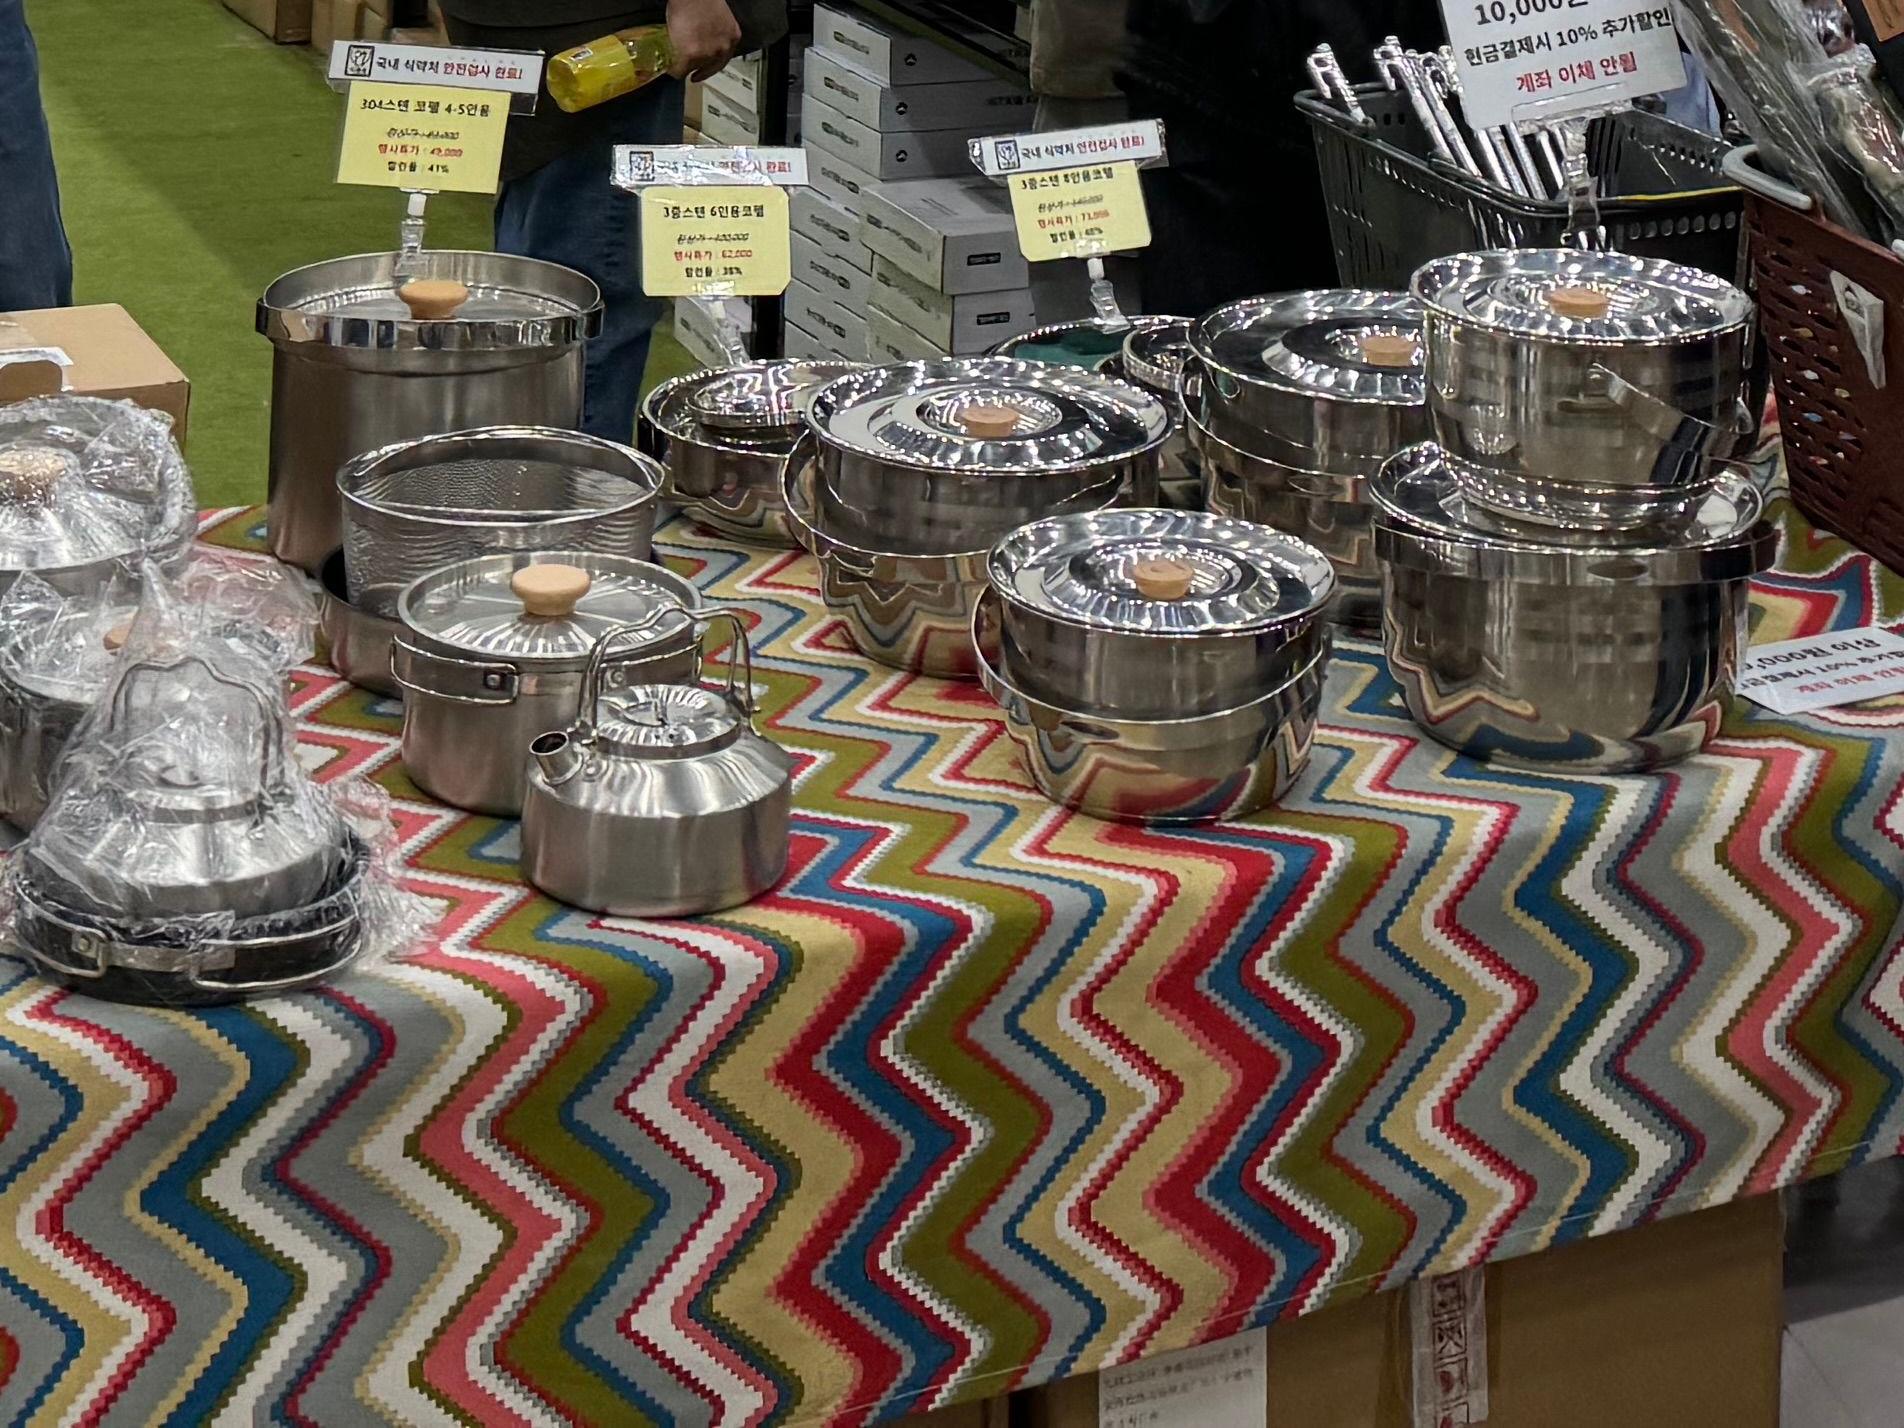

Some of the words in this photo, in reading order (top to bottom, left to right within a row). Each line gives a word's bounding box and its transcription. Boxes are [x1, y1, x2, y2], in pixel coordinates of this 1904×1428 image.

[1464, 32, 1552, 67] 현금결제시
[1556, 25, 1598, 48] 10%
[1601, 7, 1672, 38] 추가할인
[1516, 69, 1552, 92] 계좌
[1559, 60, 1595, 84] 이체
